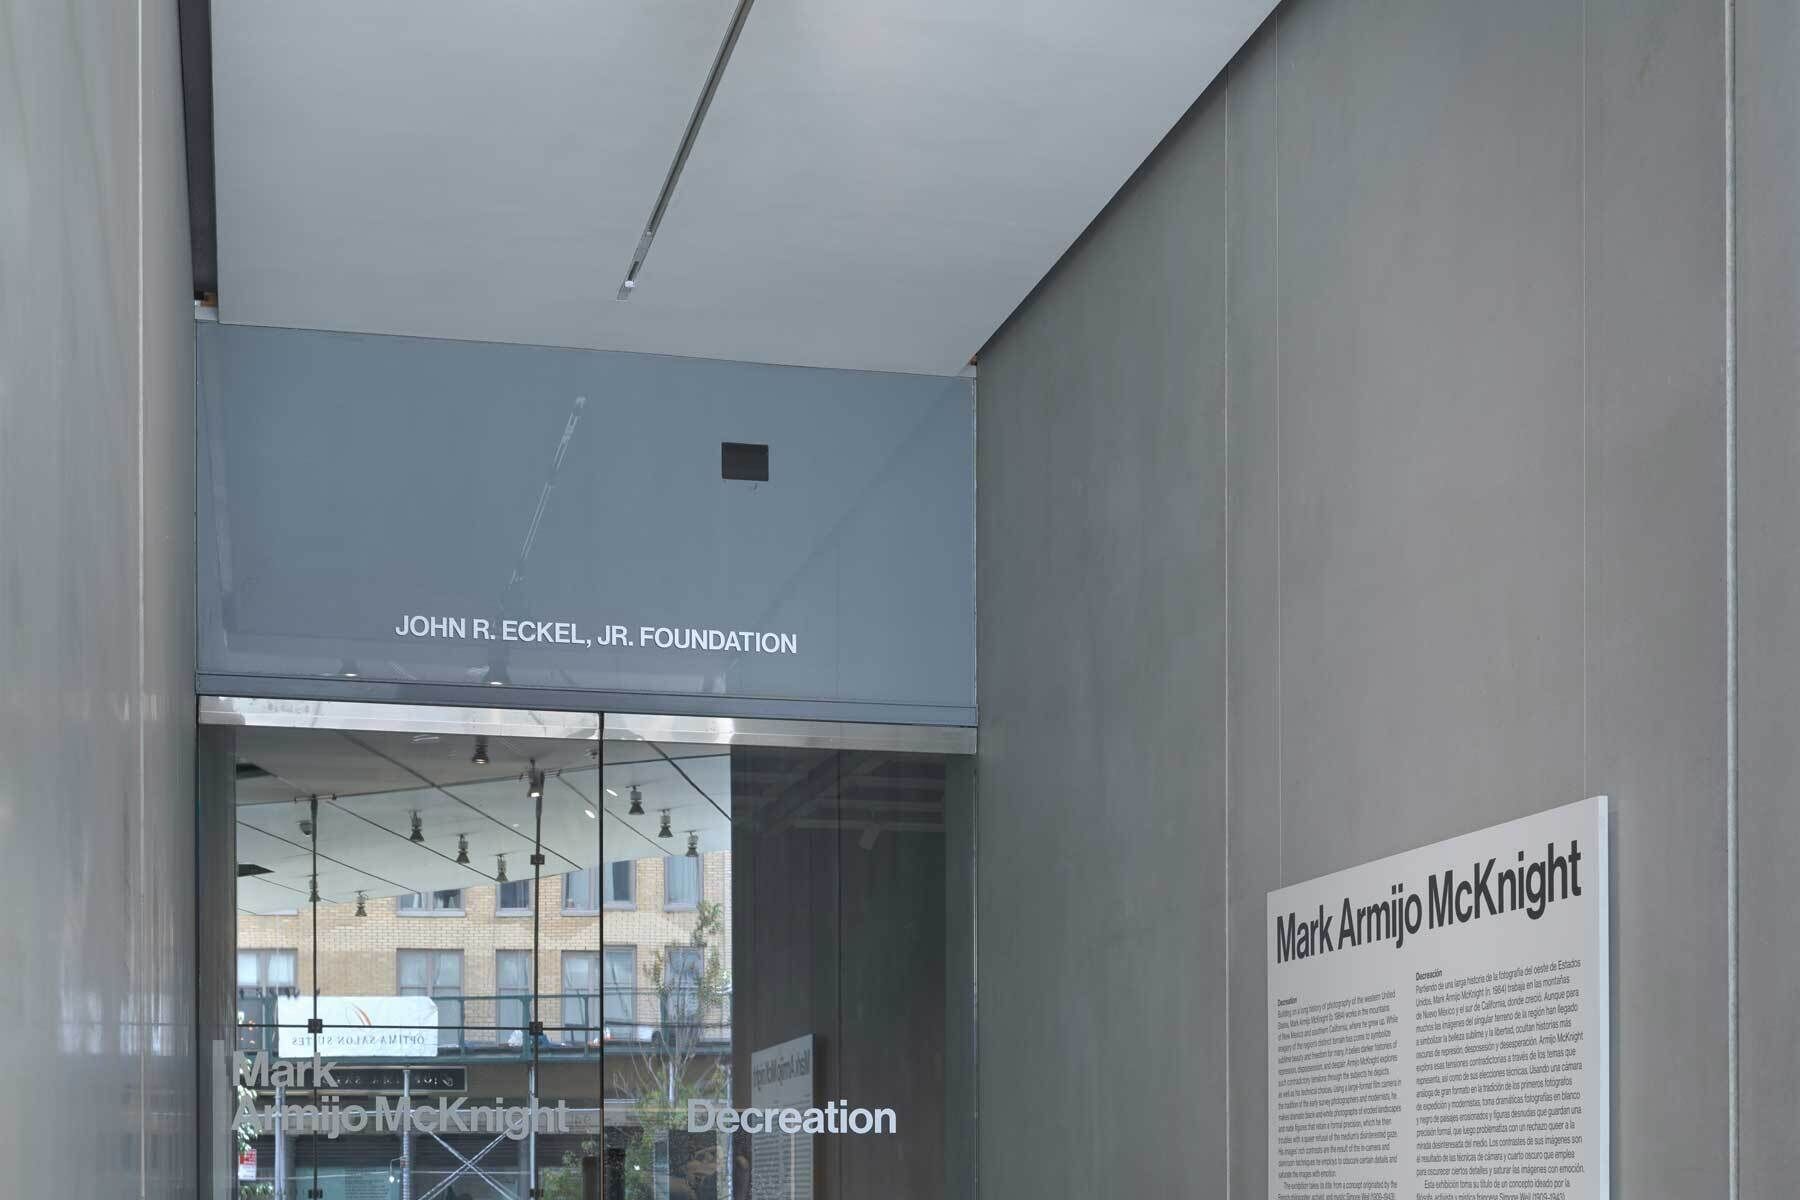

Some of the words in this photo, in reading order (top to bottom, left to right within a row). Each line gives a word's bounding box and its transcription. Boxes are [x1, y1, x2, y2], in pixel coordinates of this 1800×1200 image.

[394, 614, 466, 640] JOHN
[472, 617, 496, 641] R.
[502, 619, 591, 648] ECKEL,
[597, 624, 634, 647] JR.
[640, 626, 798, 655] FOUNDATION
[1276, 903, 1334, 965] Mark
[1337, 882, 1423, 949] Armijo
[1428, 839, 1582, 930] McKnight
[232, 1051, 338, 1088] Mark
[231, 1094, 368, 1139] Armijo
[375, 1094, 570, 1141] McKnight
[687, 1098, 897, 1135] Decreation
